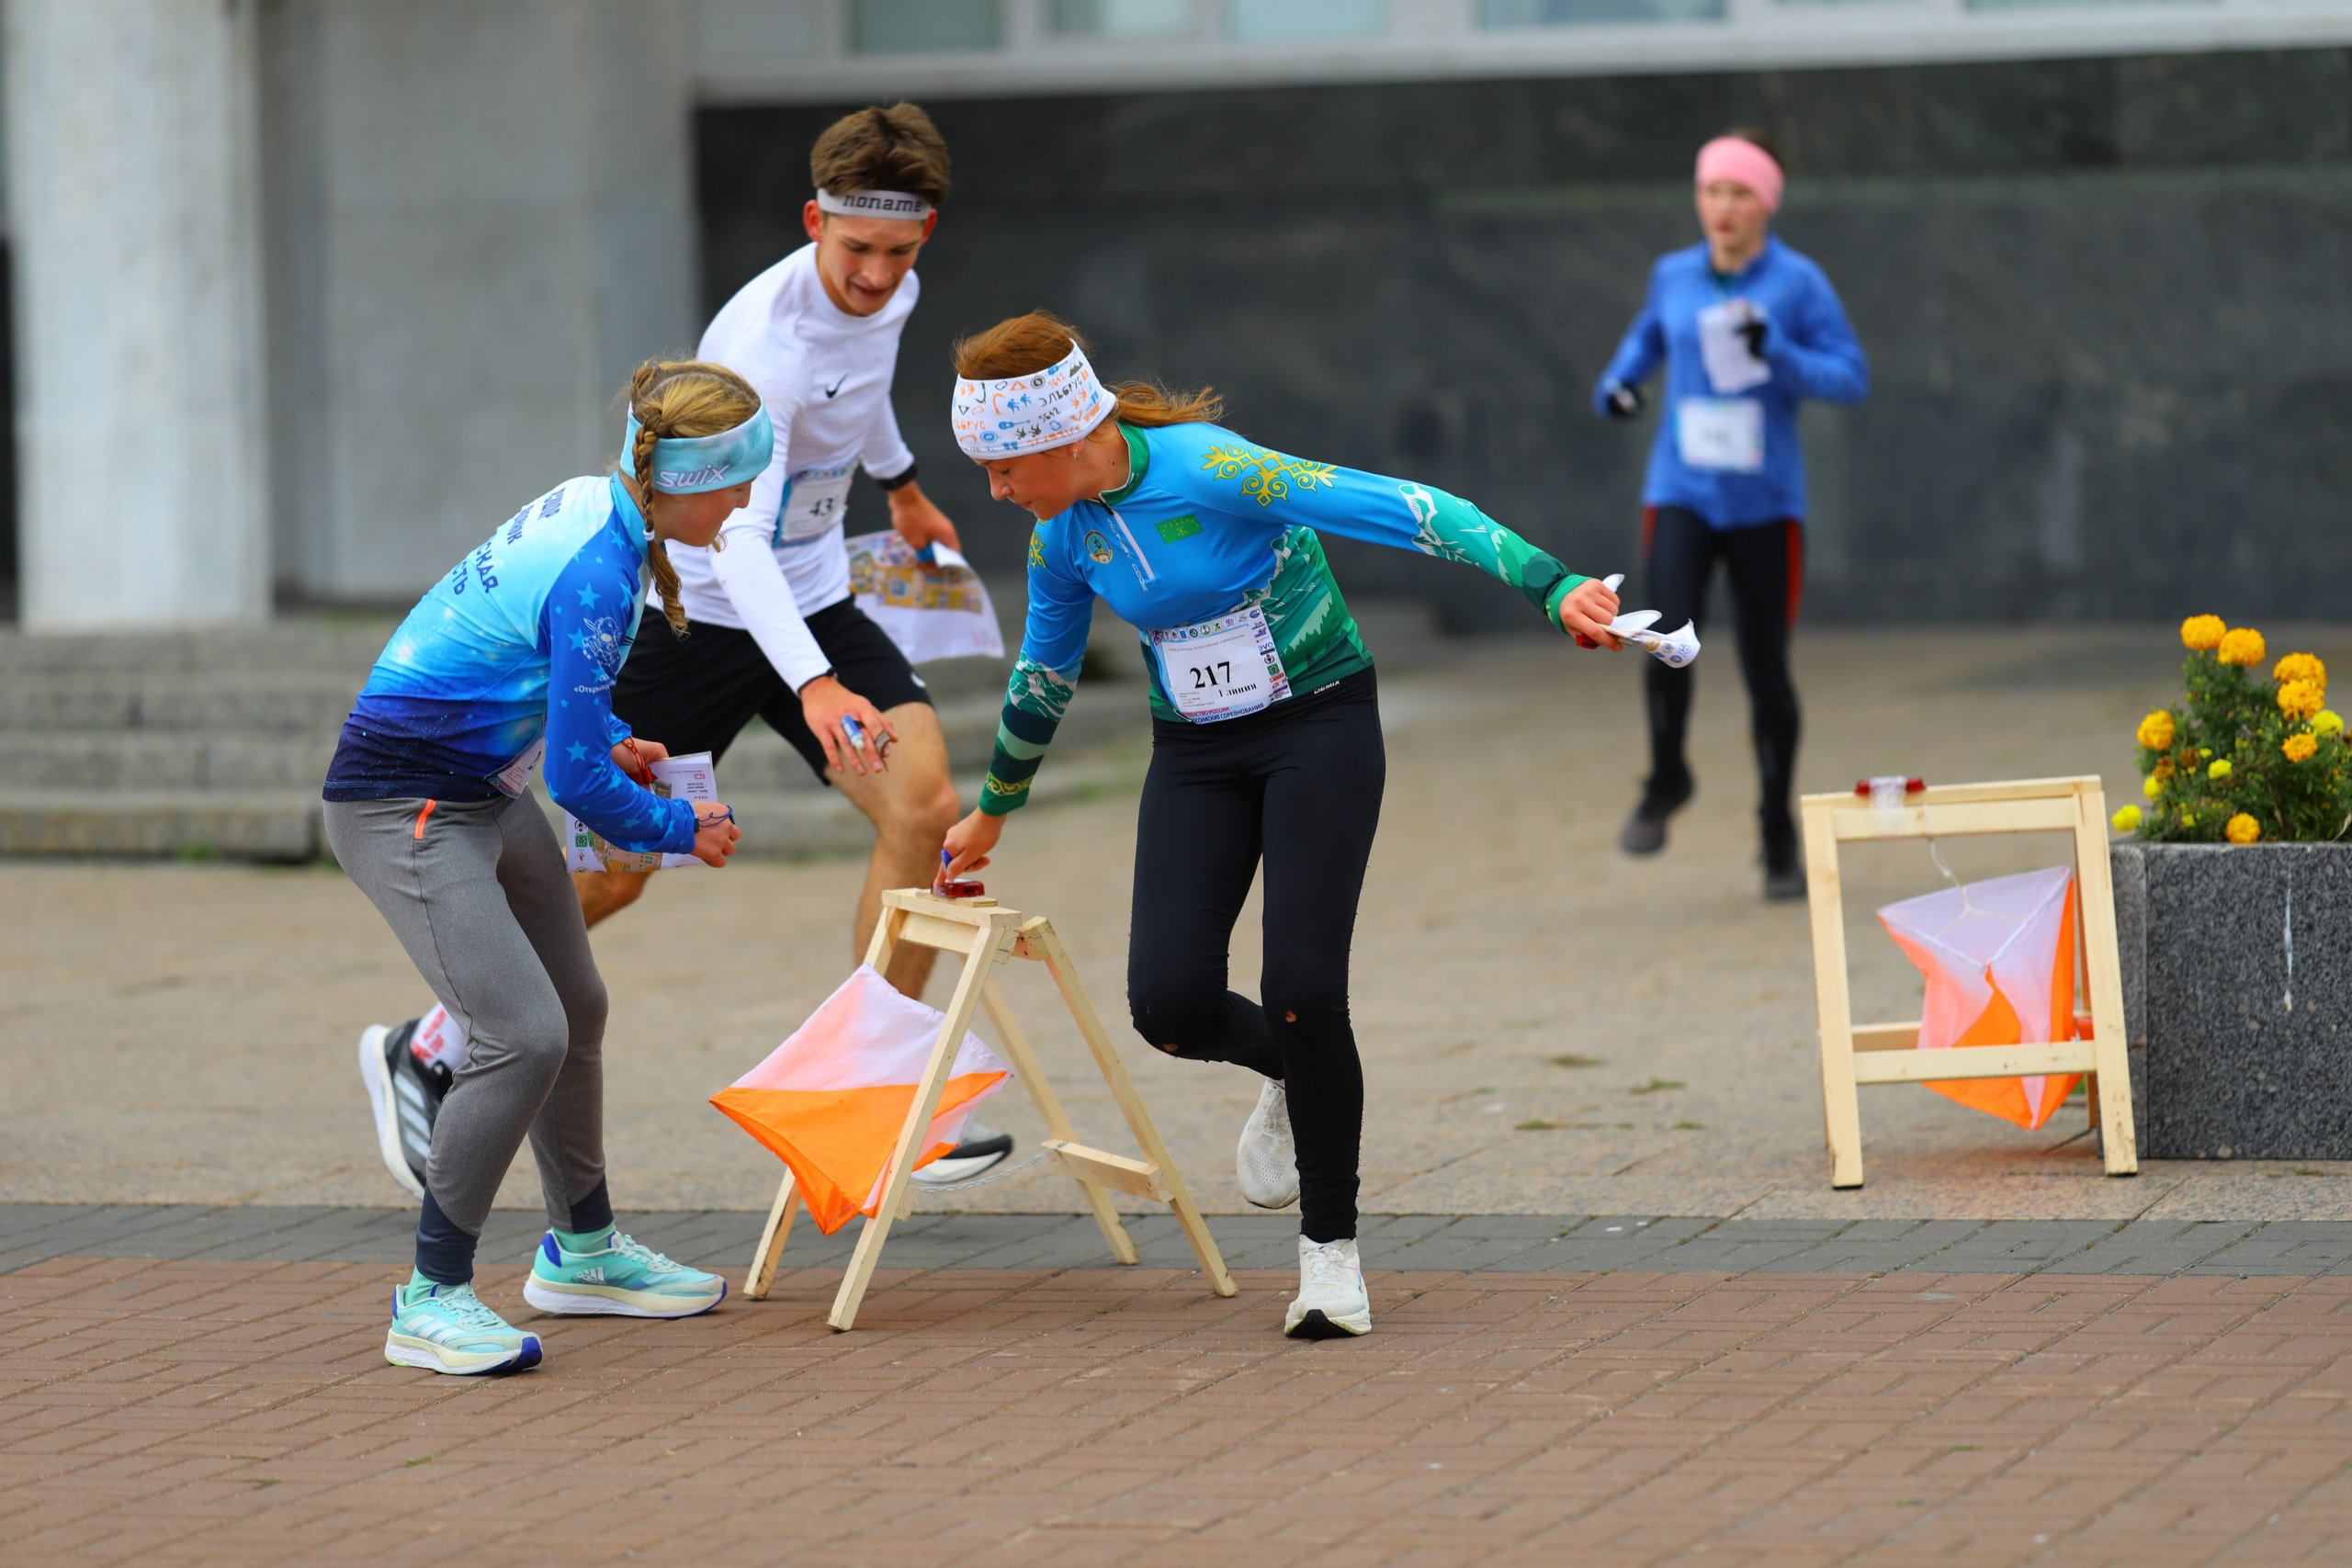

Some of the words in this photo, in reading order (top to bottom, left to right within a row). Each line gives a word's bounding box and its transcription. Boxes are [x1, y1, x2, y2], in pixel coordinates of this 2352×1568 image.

[842, 195, 923, 212] noname
[1190, 661, 1230, 689] 217
[1313, 680, 1341, 694] DEMIX
